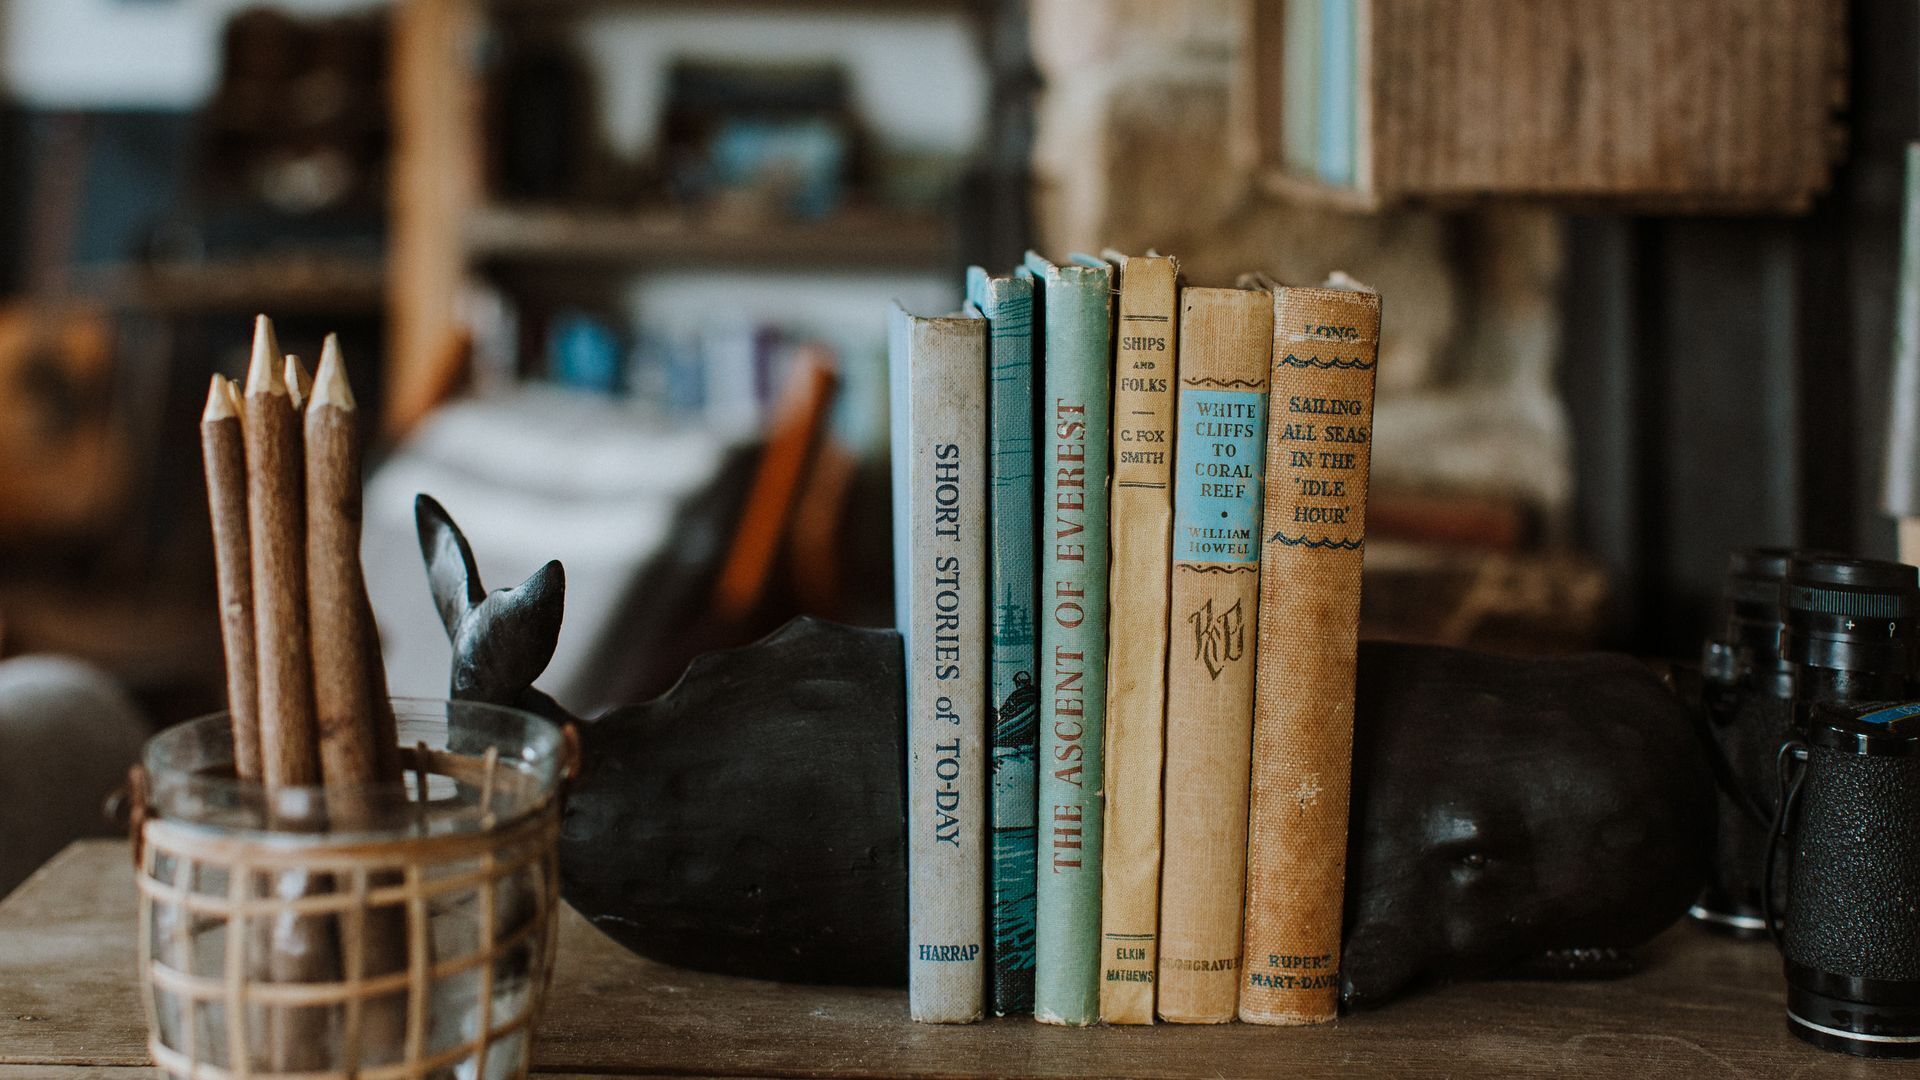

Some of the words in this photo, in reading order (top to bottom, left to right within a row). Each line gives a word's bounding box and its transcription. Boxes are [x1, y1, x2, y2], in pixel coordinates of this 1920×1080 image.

[1122, 337, 1166, 351] SHIPS
[1133, 361, 1155, 370] AND
[1121, 378, 1167, 392] FOLKS
[1197, 402, 1256, 419] WHITE
[1289, 396, 1362, 415] SAILING
[1136, 430, 1165, 442] FOX
[1195, 422, 1254, 438] CLIFFS
[1281, 424, 1317, 441] ALL
[1324, 426, 1367, 443] SEAS
[1120, 451, 1164, 464] SMITH
[1212, 443, 1236, 457] TO
[1290, 451, 1313, 468] IN
[1320, 453, 1355, 469] THE
[1195, 463, 1252, 478] CORAL
[1056, 398, 1086, 564] EVEREST
[935, 443, 960, 542] SHORT
[1200, 483, 1246, 498] REEF
[1189, 528, 1250, 539] WILLIAM
[1189, 542, 1250, 554] HOWELL
[1055, 580, 1085, 629] OF
[935, 556, 960, 680] STORIES
[935, 696, 960, 726] of
[1053, 645, 1084, 789] ASCENT
[935, 744, 961, 849] TO-DAY
[1053, 804, 1083, 874] THE
[919, 944, 980, 962] HARRAP
[1116, 948, 1146, 960] ELKIN
[1268, 954, 1331, 969] RUPERT
[1106, 969, 1154, 982] MATHEWS
